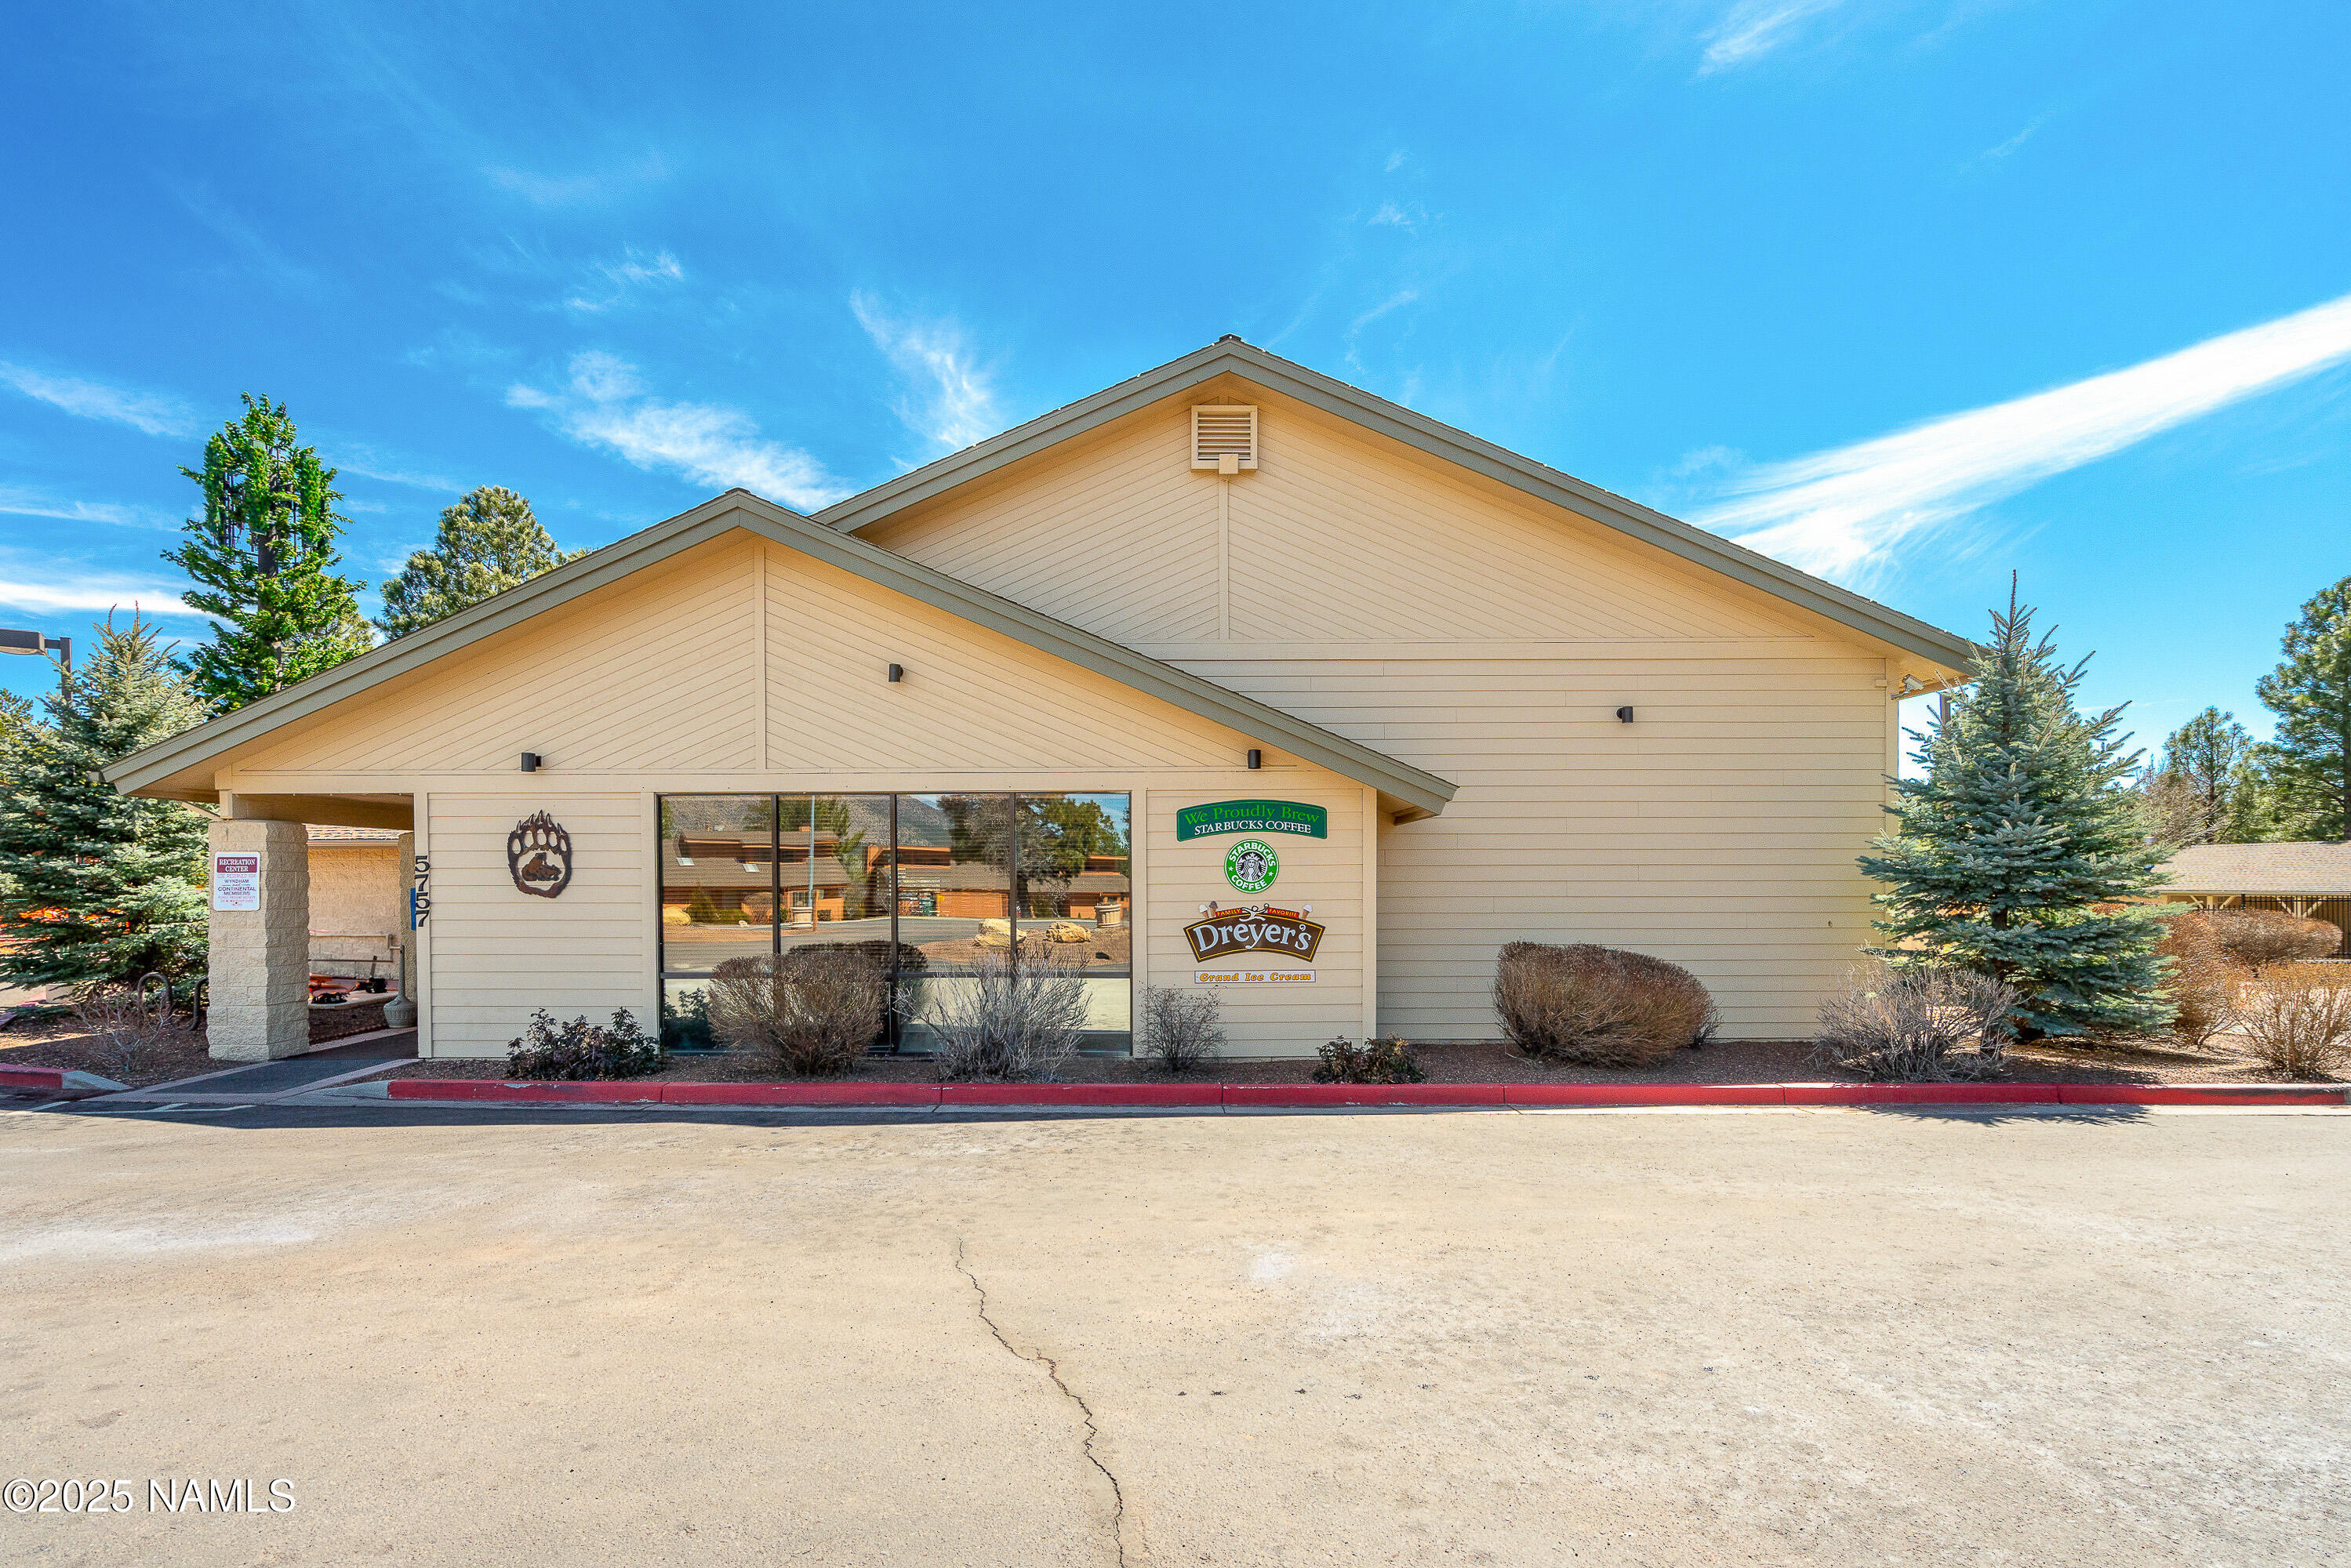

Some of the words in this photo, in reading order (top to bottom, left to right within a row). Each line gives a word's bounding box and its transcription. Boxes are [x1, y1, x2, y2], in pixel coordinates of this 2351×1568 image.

[1184, 810, 1208, 826] We
[1213, 804, 1275, 820] Proudly
[1281, 805, 1320, 823] Brew
[1194, 820, 1263, 836] STARBUCKS
[1266, 820, 1312, 834] COFFEE
[1229, 842, 1277, 867] STARBUCKS
[414, 855, 431, 927] 5757
[1231, 875, 1268, 891] COFFEE
[1216, 908, 1241, 916] FAMILY
[1269, 908, 1299, 917] FAVORITE
[1193, 923, 1311, 952] Dreyer's
[1199, 972, 1239, 982] Grand
[1245, 972, 1264, 981] Ice
[1270, 972, 1312, 981] Cream
